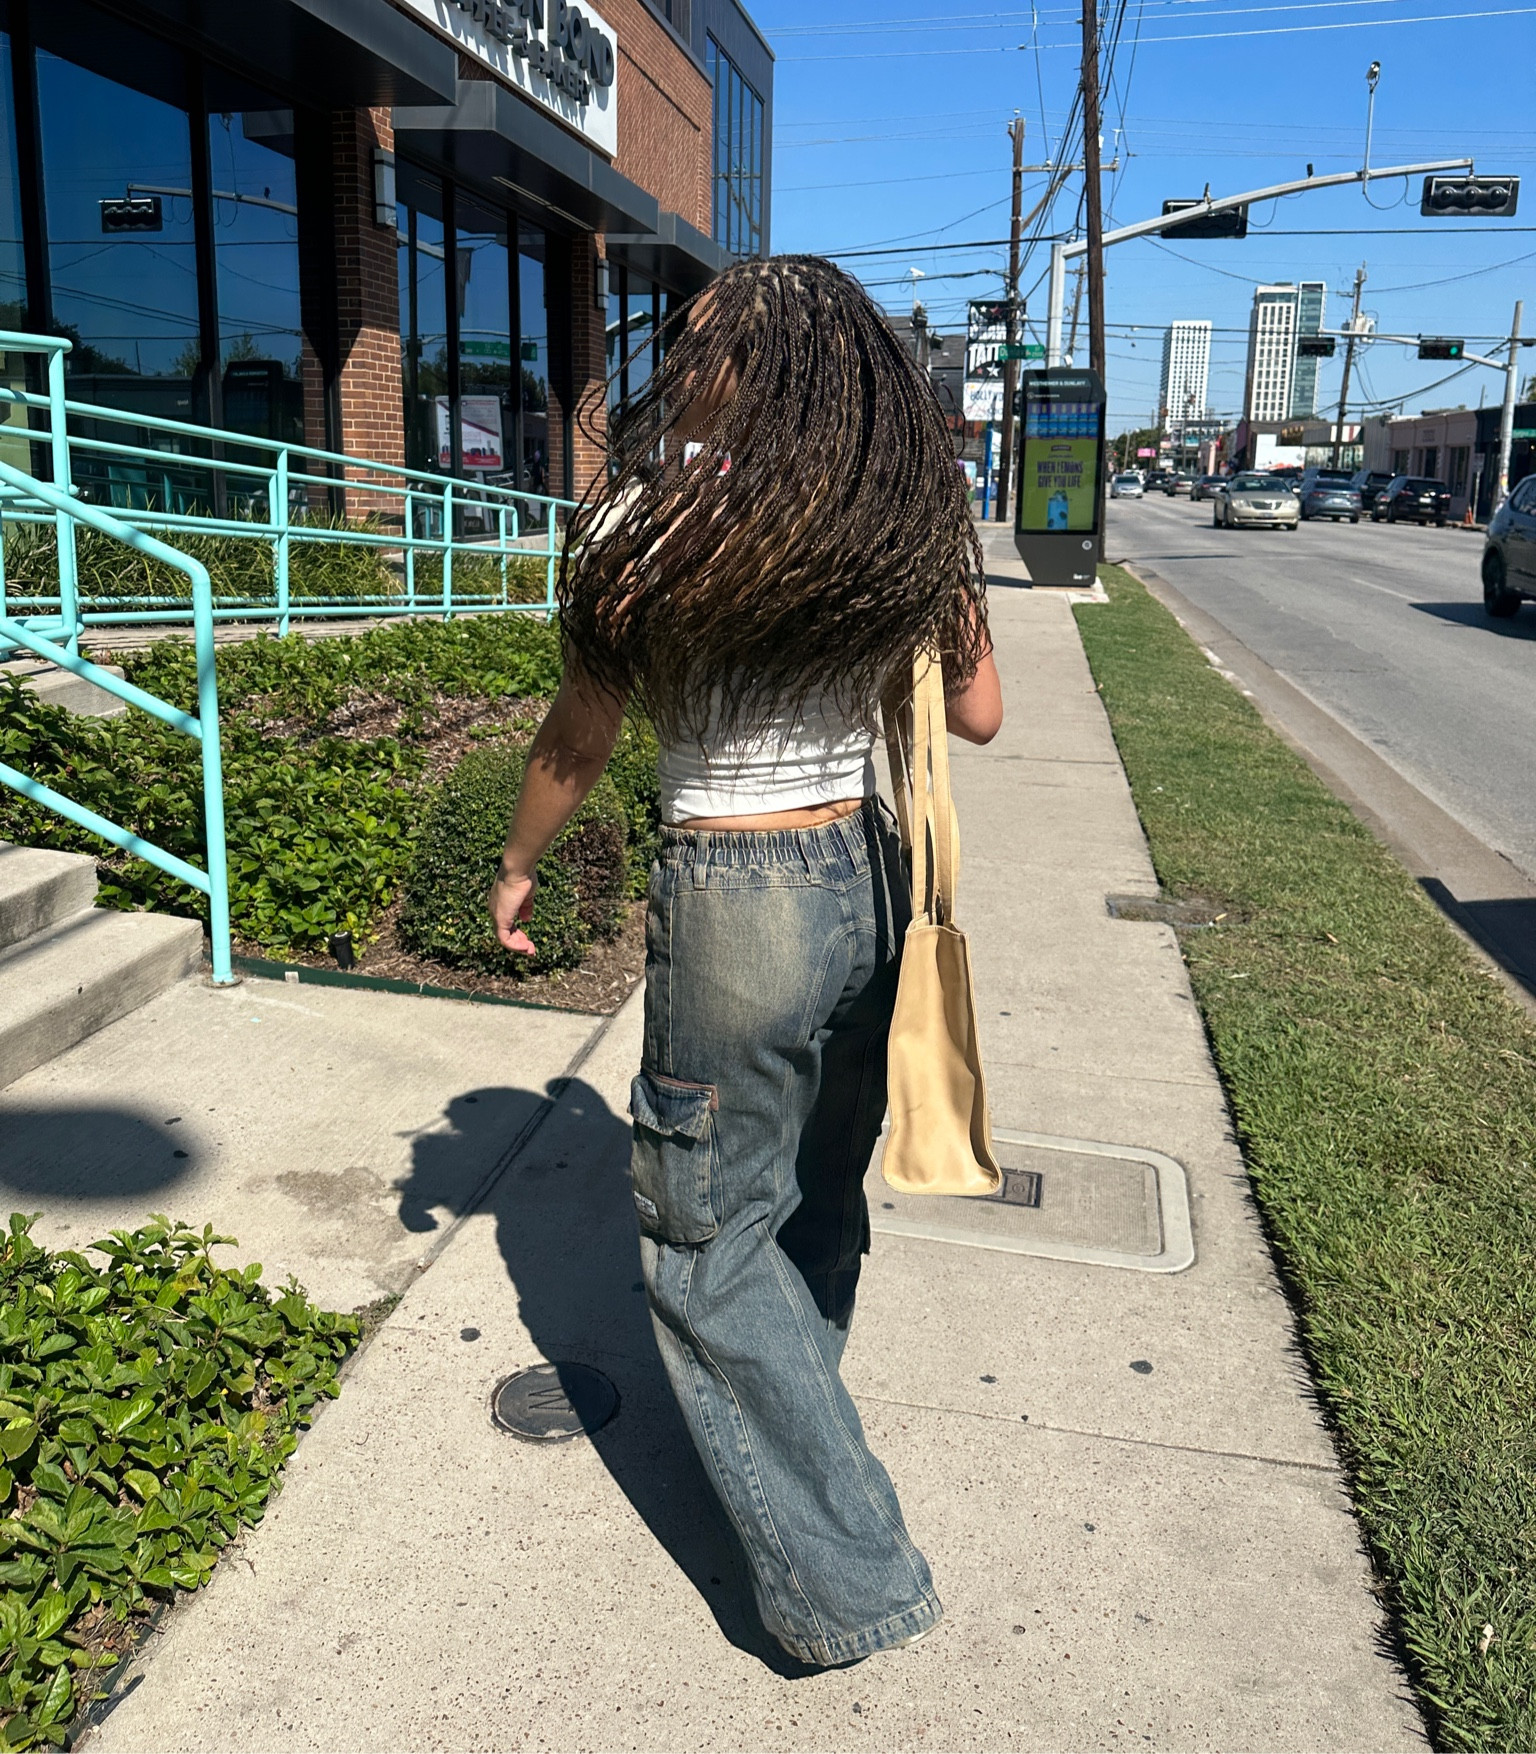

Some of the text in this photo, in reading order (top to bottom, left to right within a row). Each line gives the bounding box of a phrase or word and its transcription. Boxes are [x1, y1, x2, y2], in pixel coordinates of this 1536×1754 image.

[549, 0, 614, 87] BOND
[968, 342, 1003, 374] TATT
[1038, 461, 1055, 473] WHEN
[1038, 475, 1080, 488] GIVE YOU LIFE
